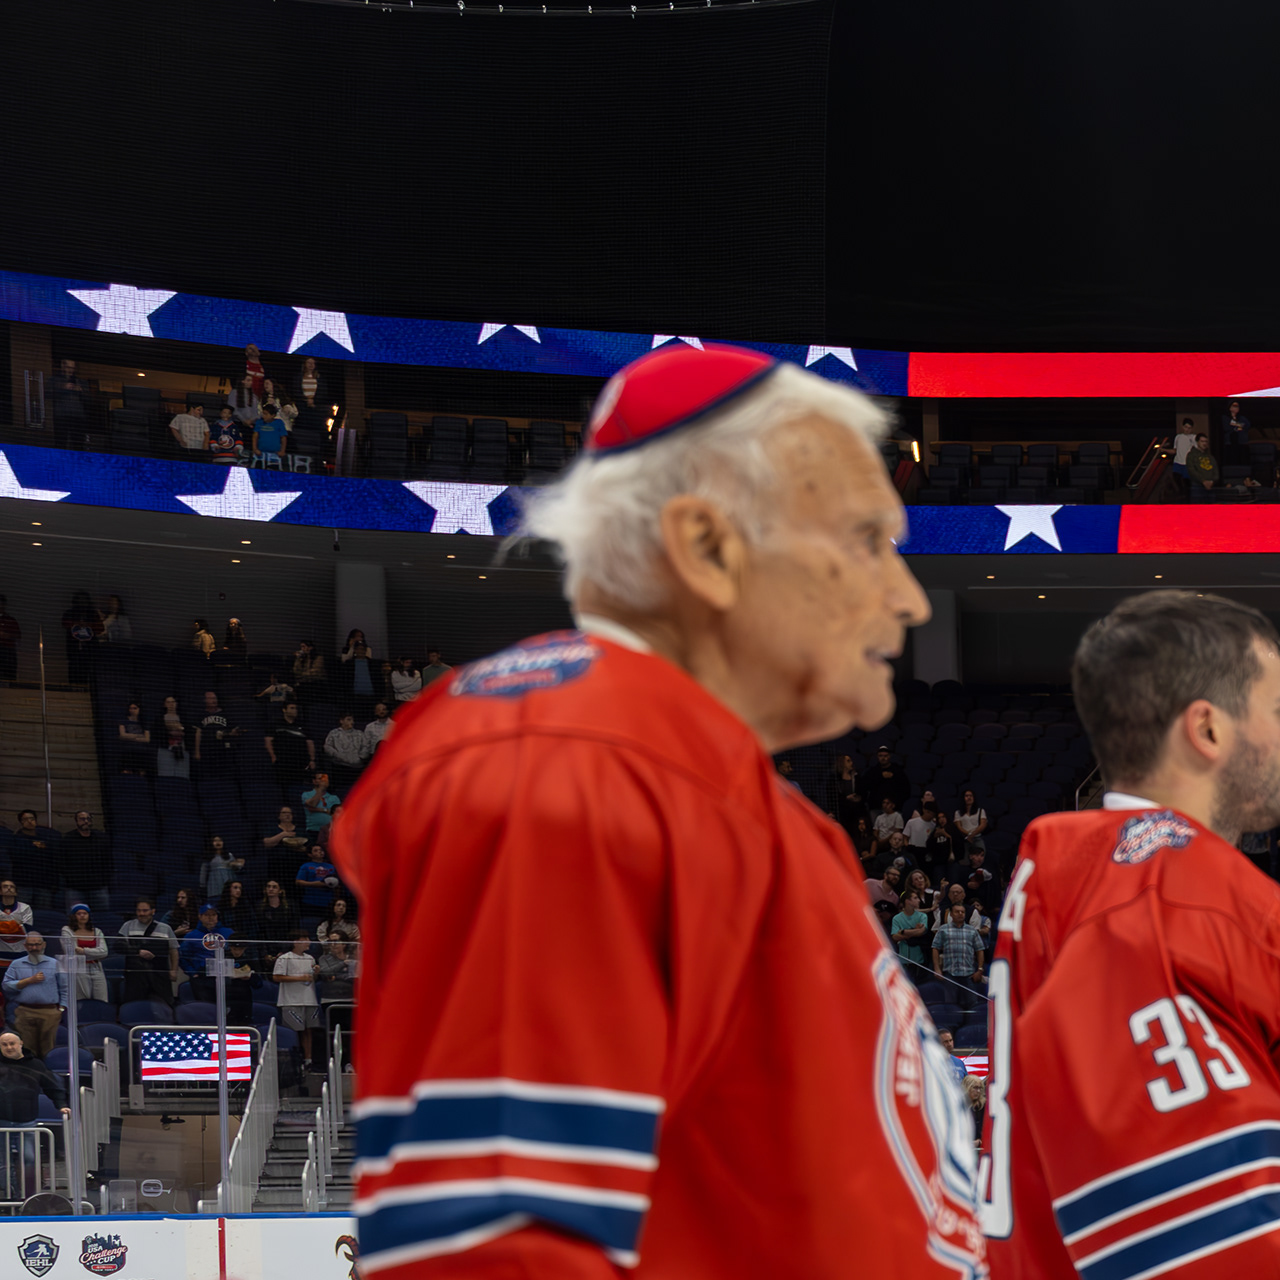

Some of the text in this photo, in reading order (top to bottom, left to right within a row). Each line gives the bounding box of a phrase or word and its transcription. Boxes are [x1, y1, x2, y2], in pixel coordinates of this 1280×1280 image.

[1128, 995, 1251, 1112] 33
[87, 1246, 103, 1254] USA
[80, 1246, 127, 1264] Challenge
[97, 1255, 116, 1264] CUP
[26, 1258, 53, 1267] IEHL
